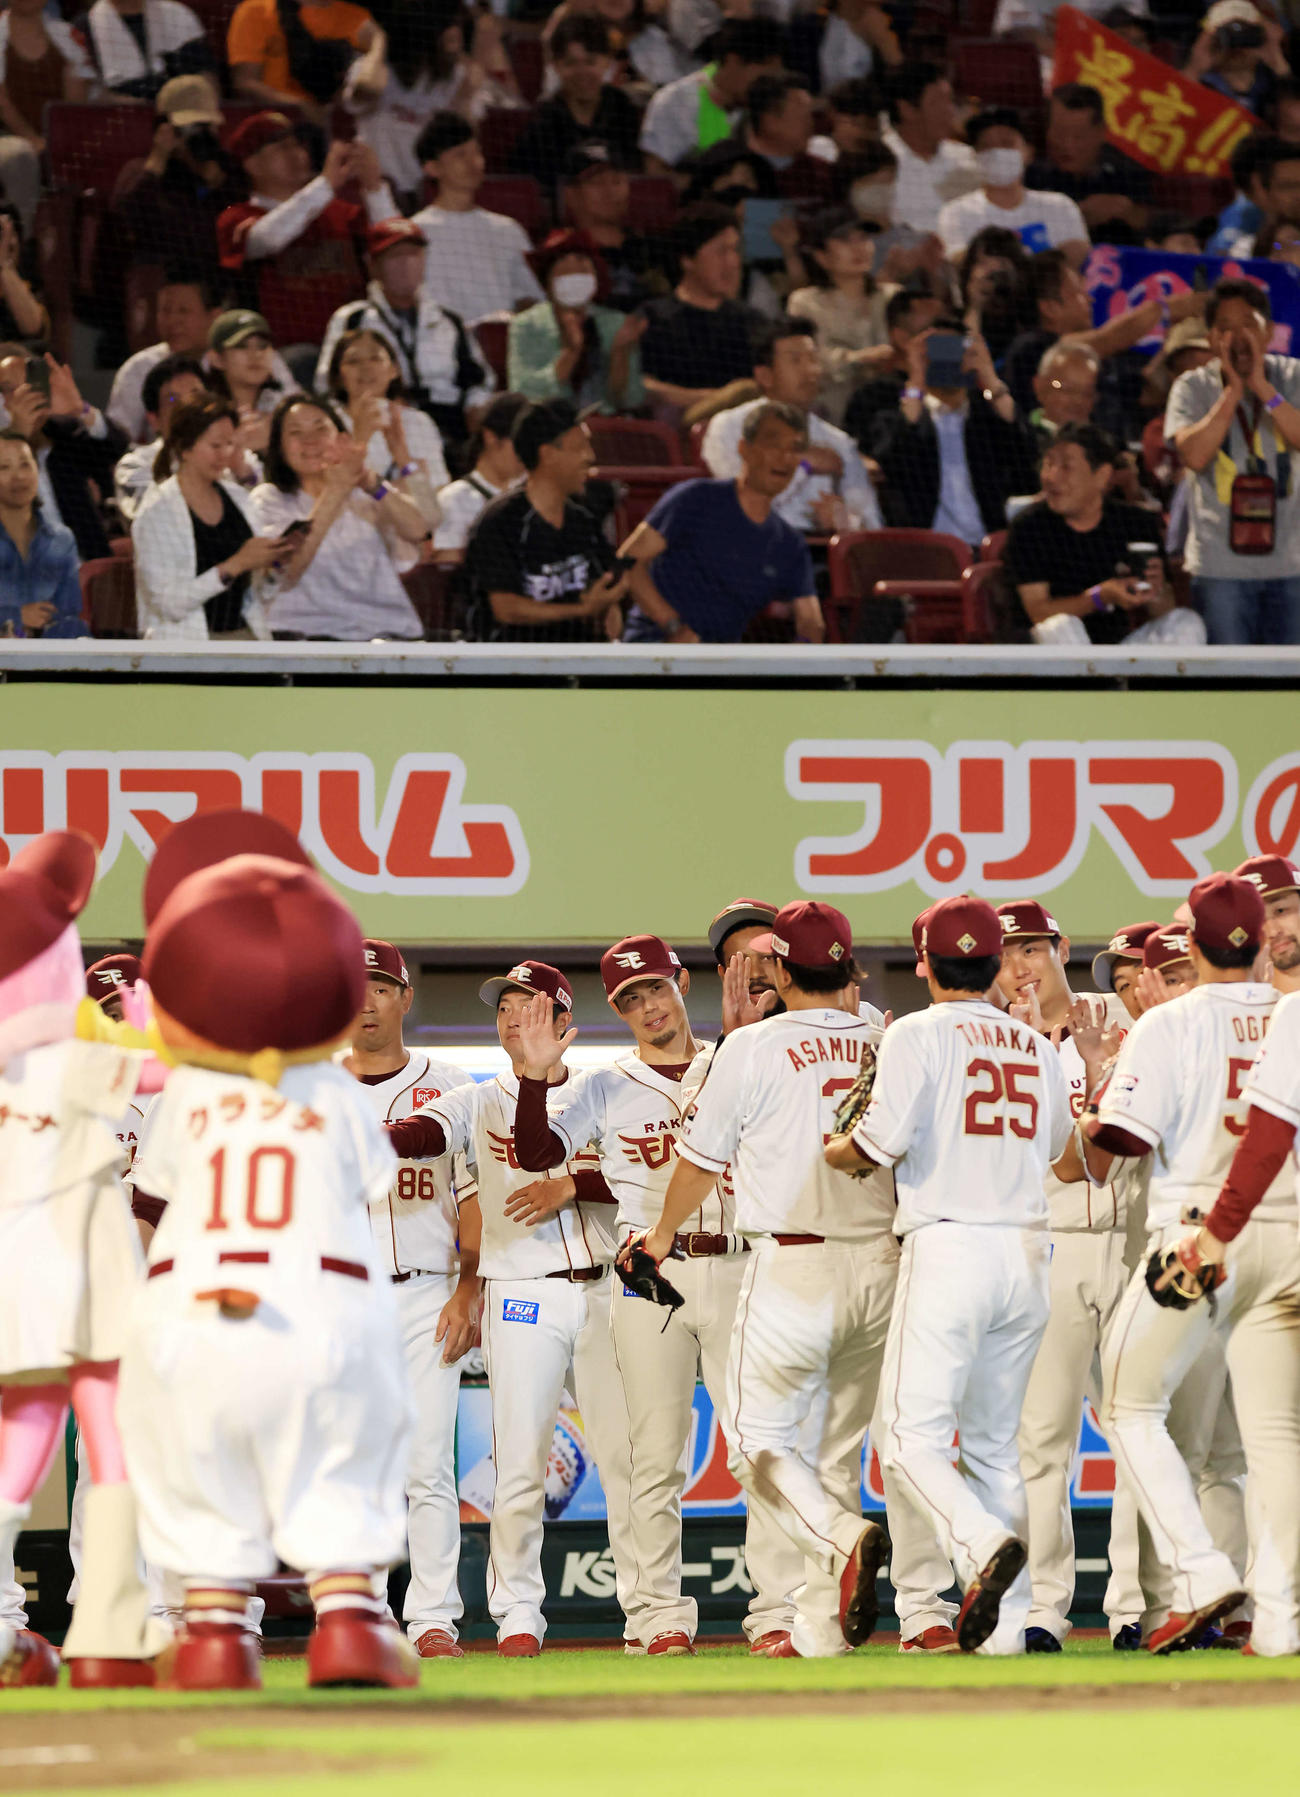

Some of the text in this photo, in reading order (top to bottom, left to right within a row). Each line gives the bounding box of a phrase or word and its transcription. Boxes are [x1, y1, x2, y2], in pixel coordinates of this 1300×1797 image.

[0, 768, 515, 877] リマハム
[956, 1022, 1037, 1057] TANAKA
[965, 1058, 1040, 1140] 25
[205, 1146, 296, 1230] 10
[397, 1167, 435, 1200] 86
[506, 1300, 536, 1316] Fuji
